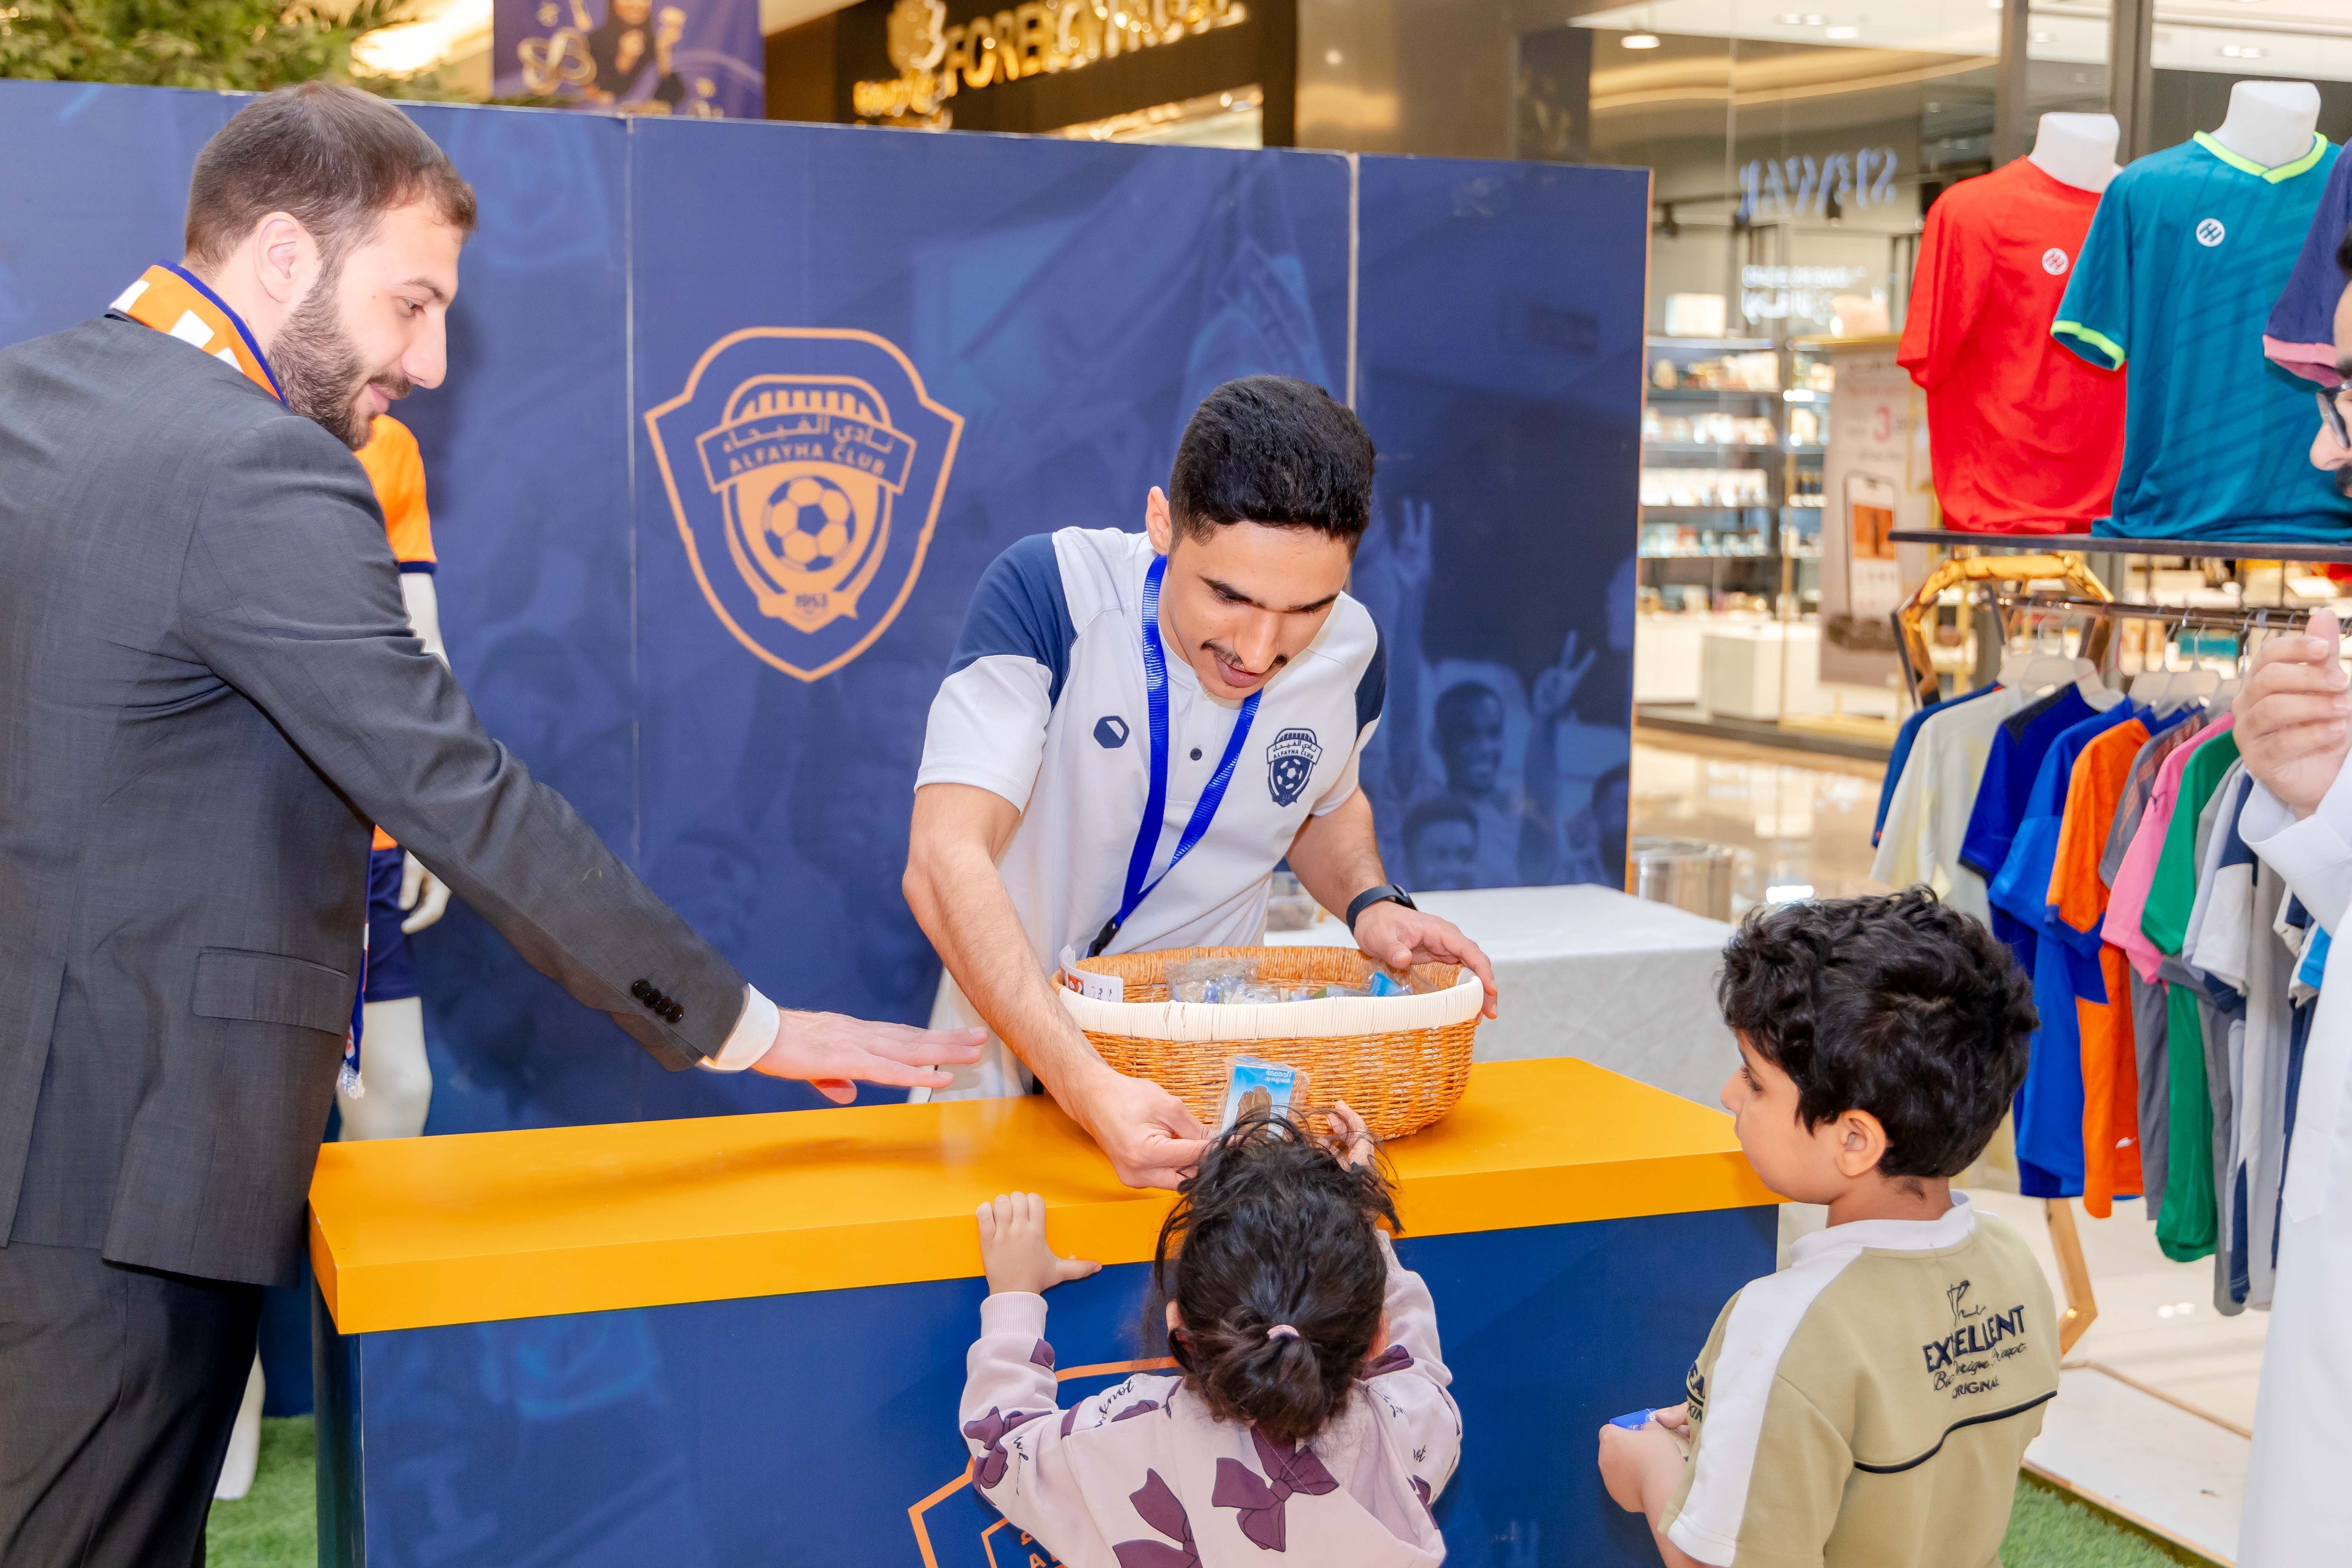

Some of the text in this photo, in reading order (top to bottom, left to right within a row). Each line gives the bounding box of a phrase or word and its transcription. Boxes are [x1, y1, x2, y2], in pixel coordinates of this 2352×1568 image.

[729, 442, 886, 476] ALFAYHA CLUB
[1273, 749, 1314, 759] ALFAYHA CLUB
